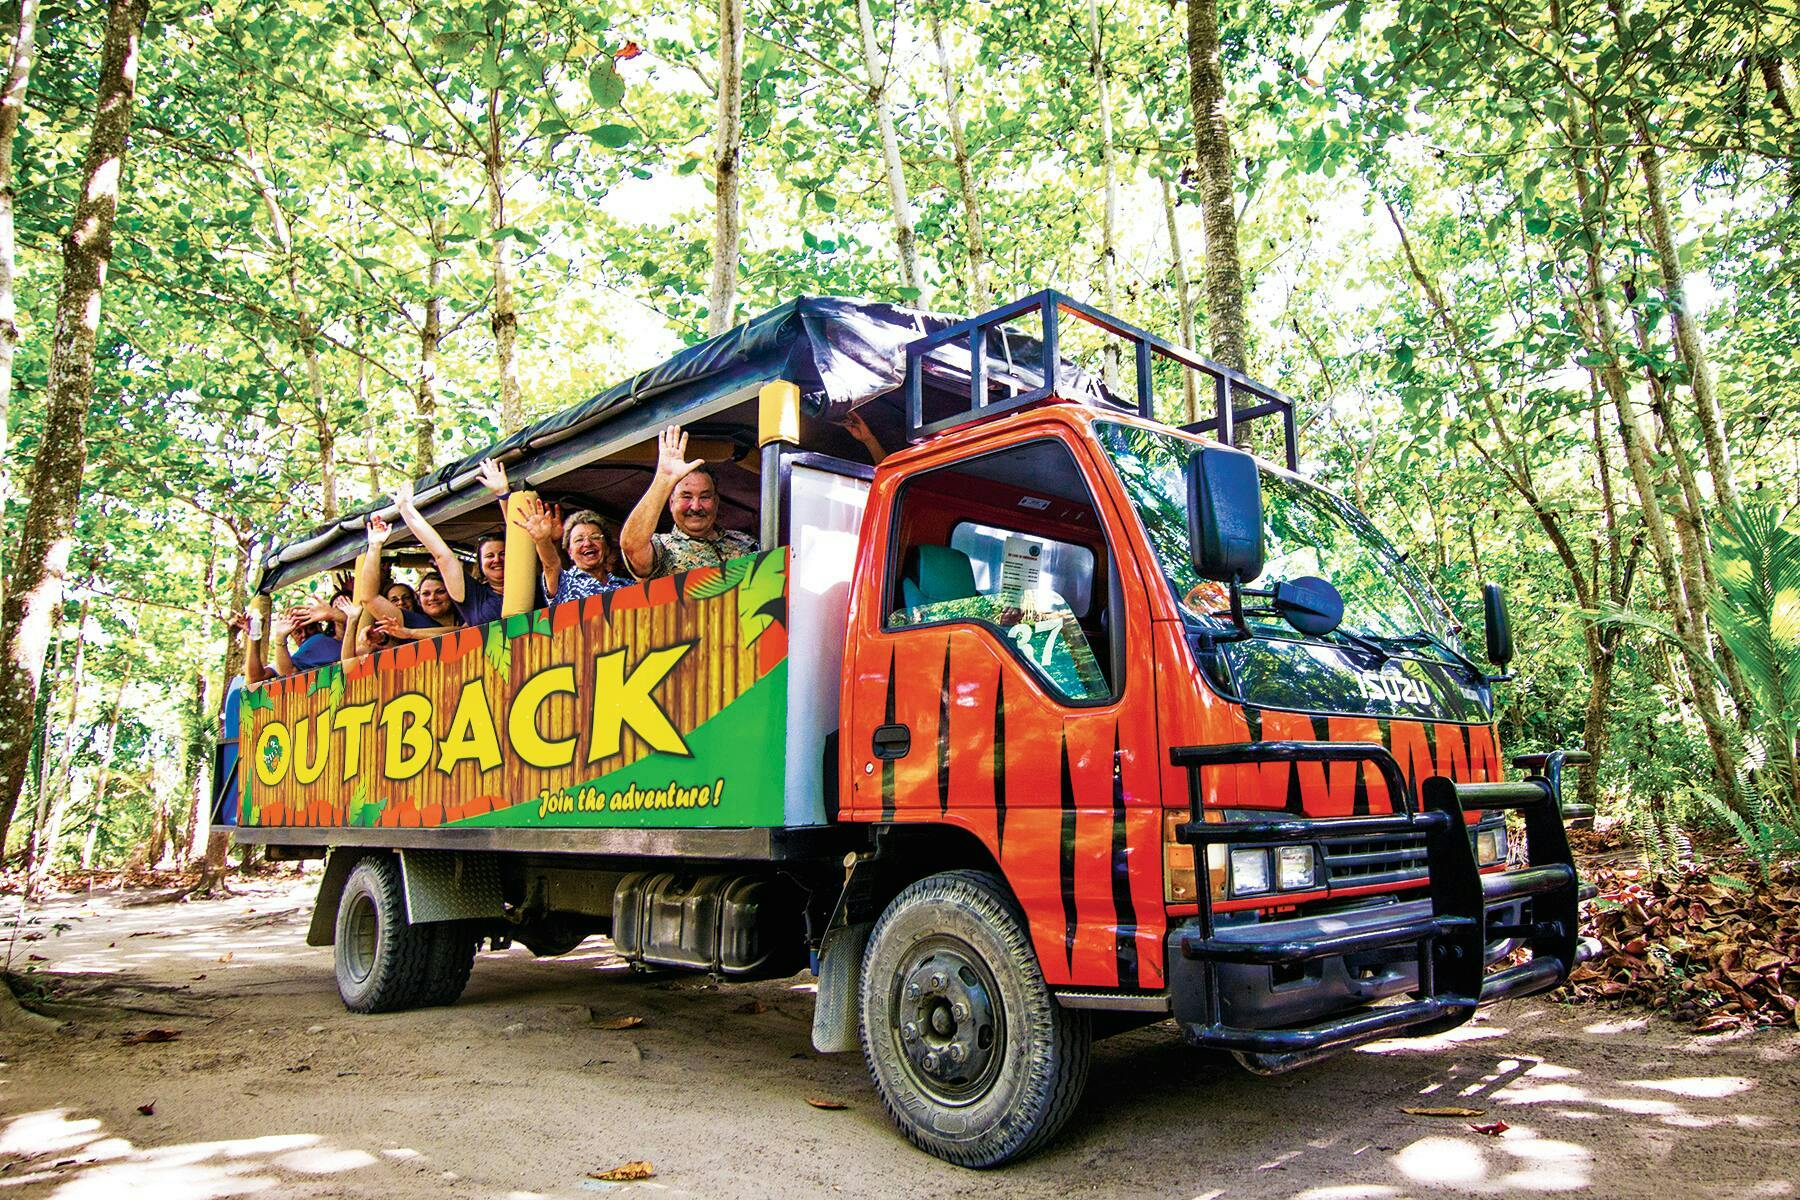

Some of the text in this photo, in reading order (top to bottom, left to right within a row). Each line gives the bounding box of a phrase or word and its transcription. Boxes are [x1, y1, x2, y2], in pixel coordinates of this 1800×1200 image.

[1008, 617, 1063, 666] 37
[1358, 673, 1431, 705] ISUZU
[255, 643, 696, 785] OUTBACK
[539, 788, 575, 818] Join
[577, 786, 606, 811] the
